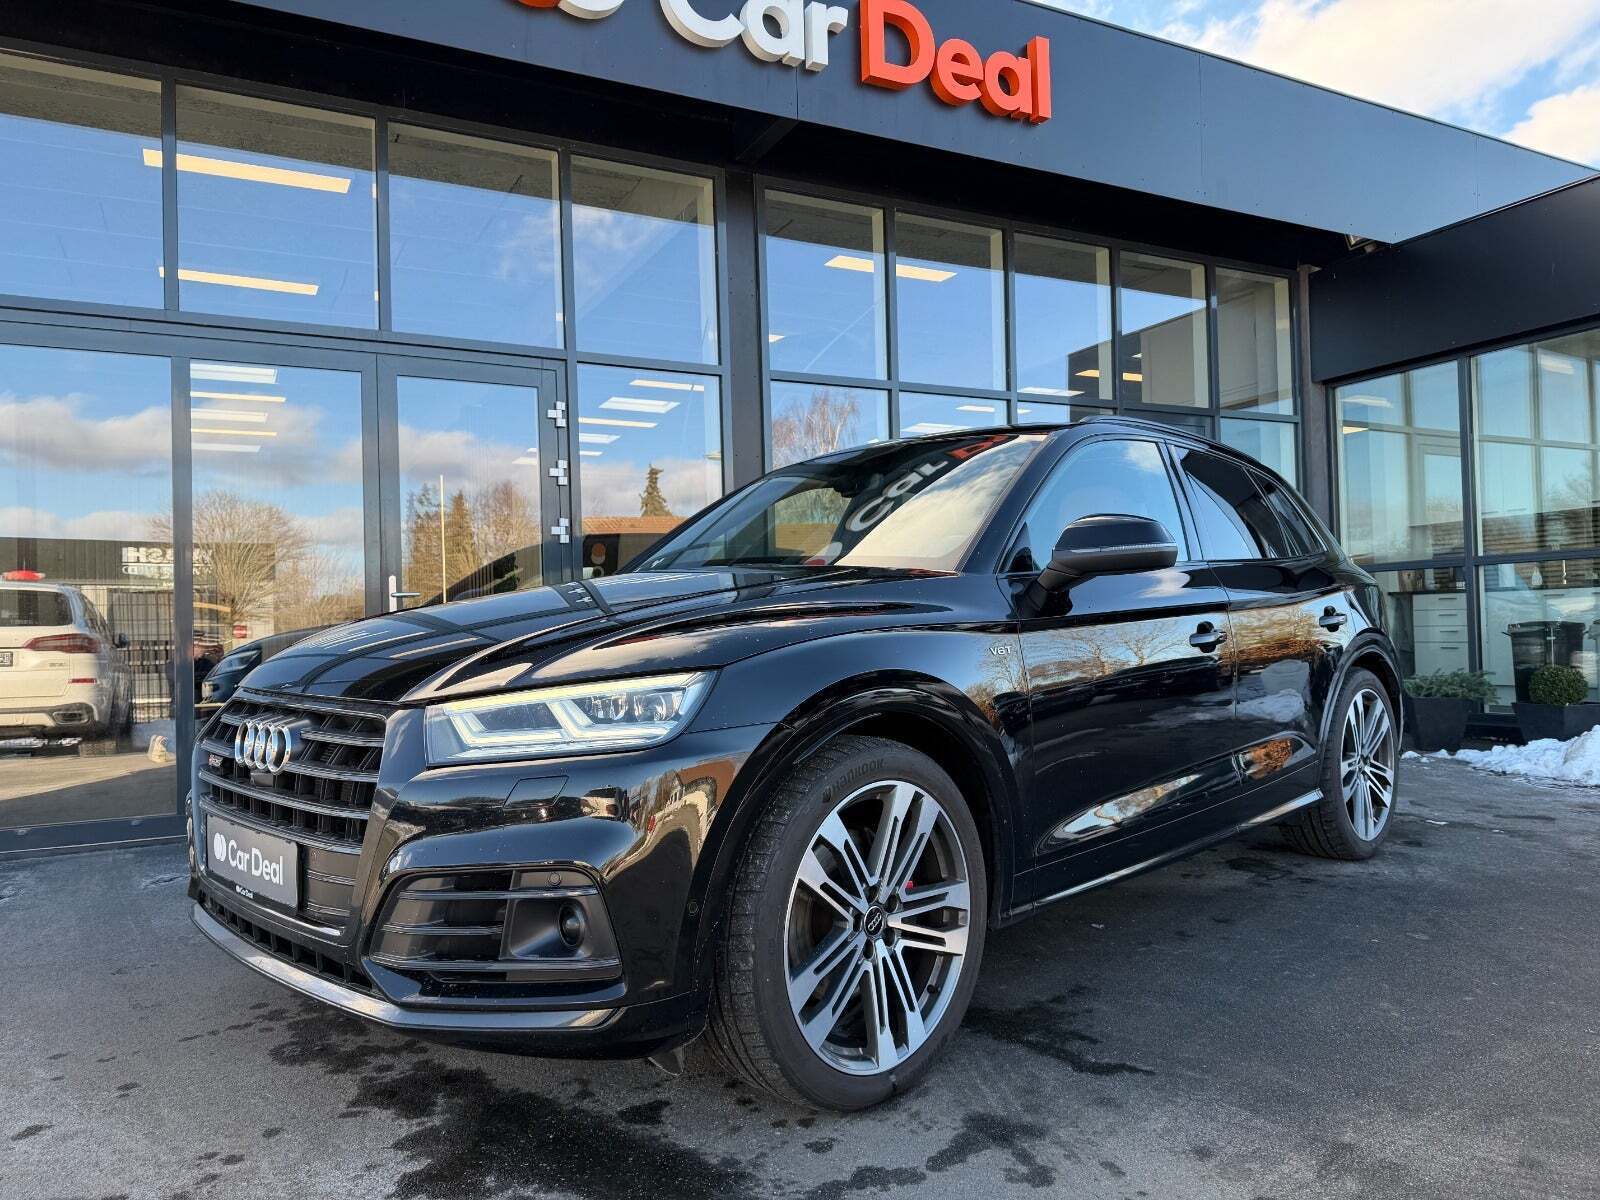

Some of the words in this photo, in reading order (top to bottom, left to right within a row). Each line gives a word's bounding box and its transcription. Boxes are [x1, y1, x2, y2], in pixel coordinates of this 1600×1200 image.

[860, 0, 1051, 124] Deal
[990, 645, 1012, 656] V6T
[228, 839, 250, 873] Car
[251, 847, 284, 886] Deal
